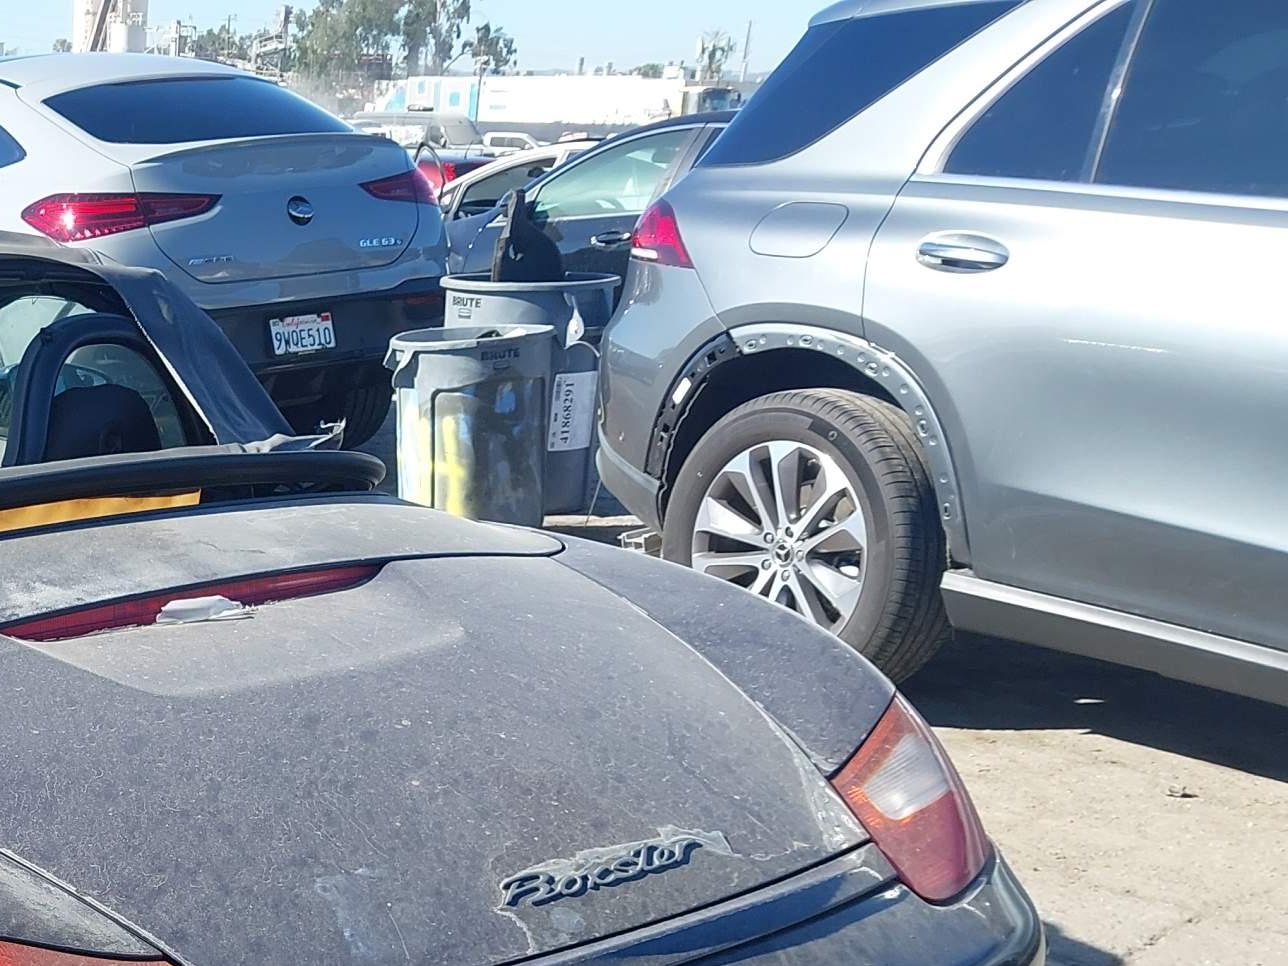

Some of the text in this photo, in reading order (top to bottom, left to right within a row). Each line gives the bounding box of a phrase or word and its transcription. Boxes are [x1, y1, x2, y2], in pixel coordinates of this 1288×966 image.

[359, 238, 380, 248] GLE
[381, 236, 395, 247] 63
[452, 295, 483, 309] BRUTE
[481, 347, 521, 361] BRUTE
[559, 383, 576, 444] 41868291
[500, 838, 704, 909] Boxster
